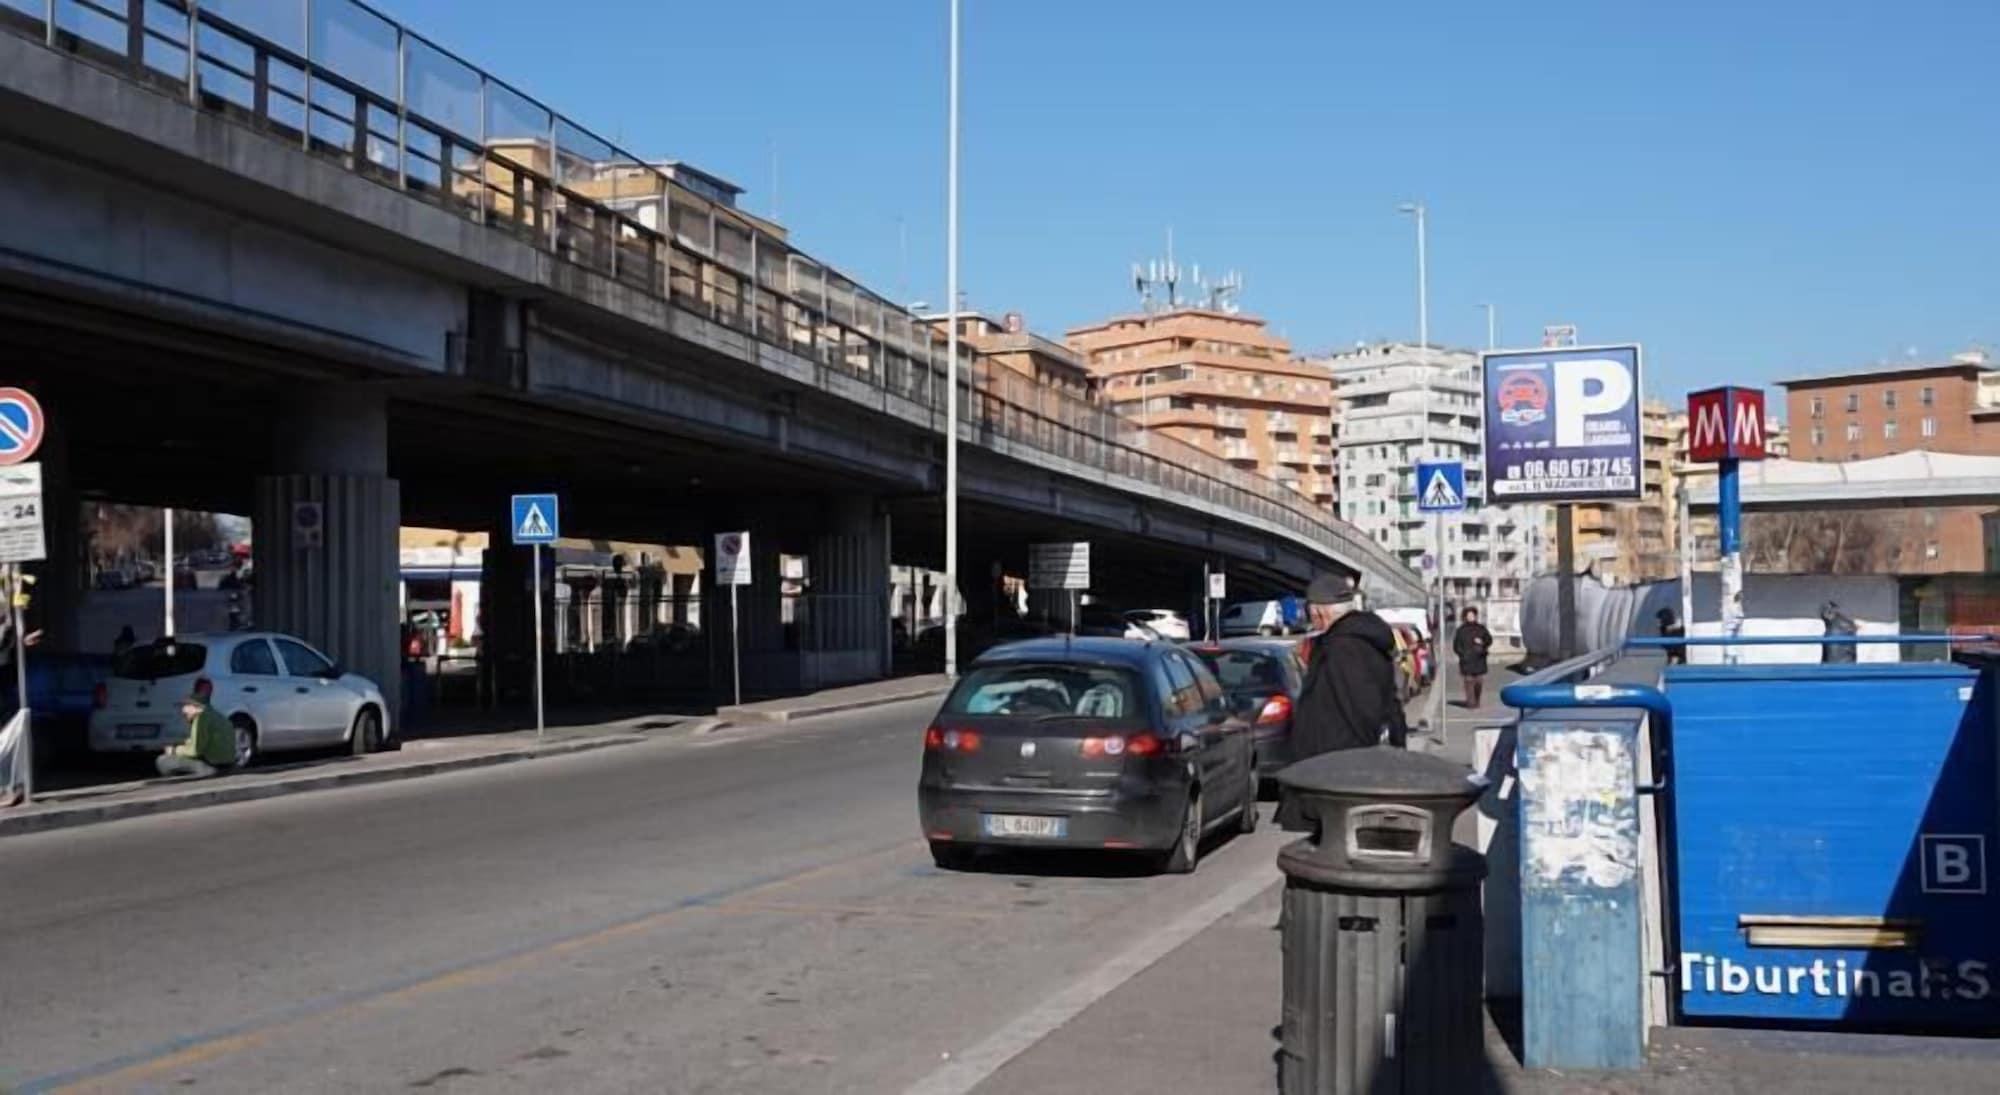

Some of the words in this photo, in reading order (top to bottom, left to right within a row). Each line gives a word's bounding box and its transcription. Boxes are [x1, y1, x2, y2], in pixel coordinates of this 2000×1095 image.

[1553, 359, 1632, 447] P
[1936, 844, 1970, 883] B
[1680, 951, 1914, 997] Tiburtina
